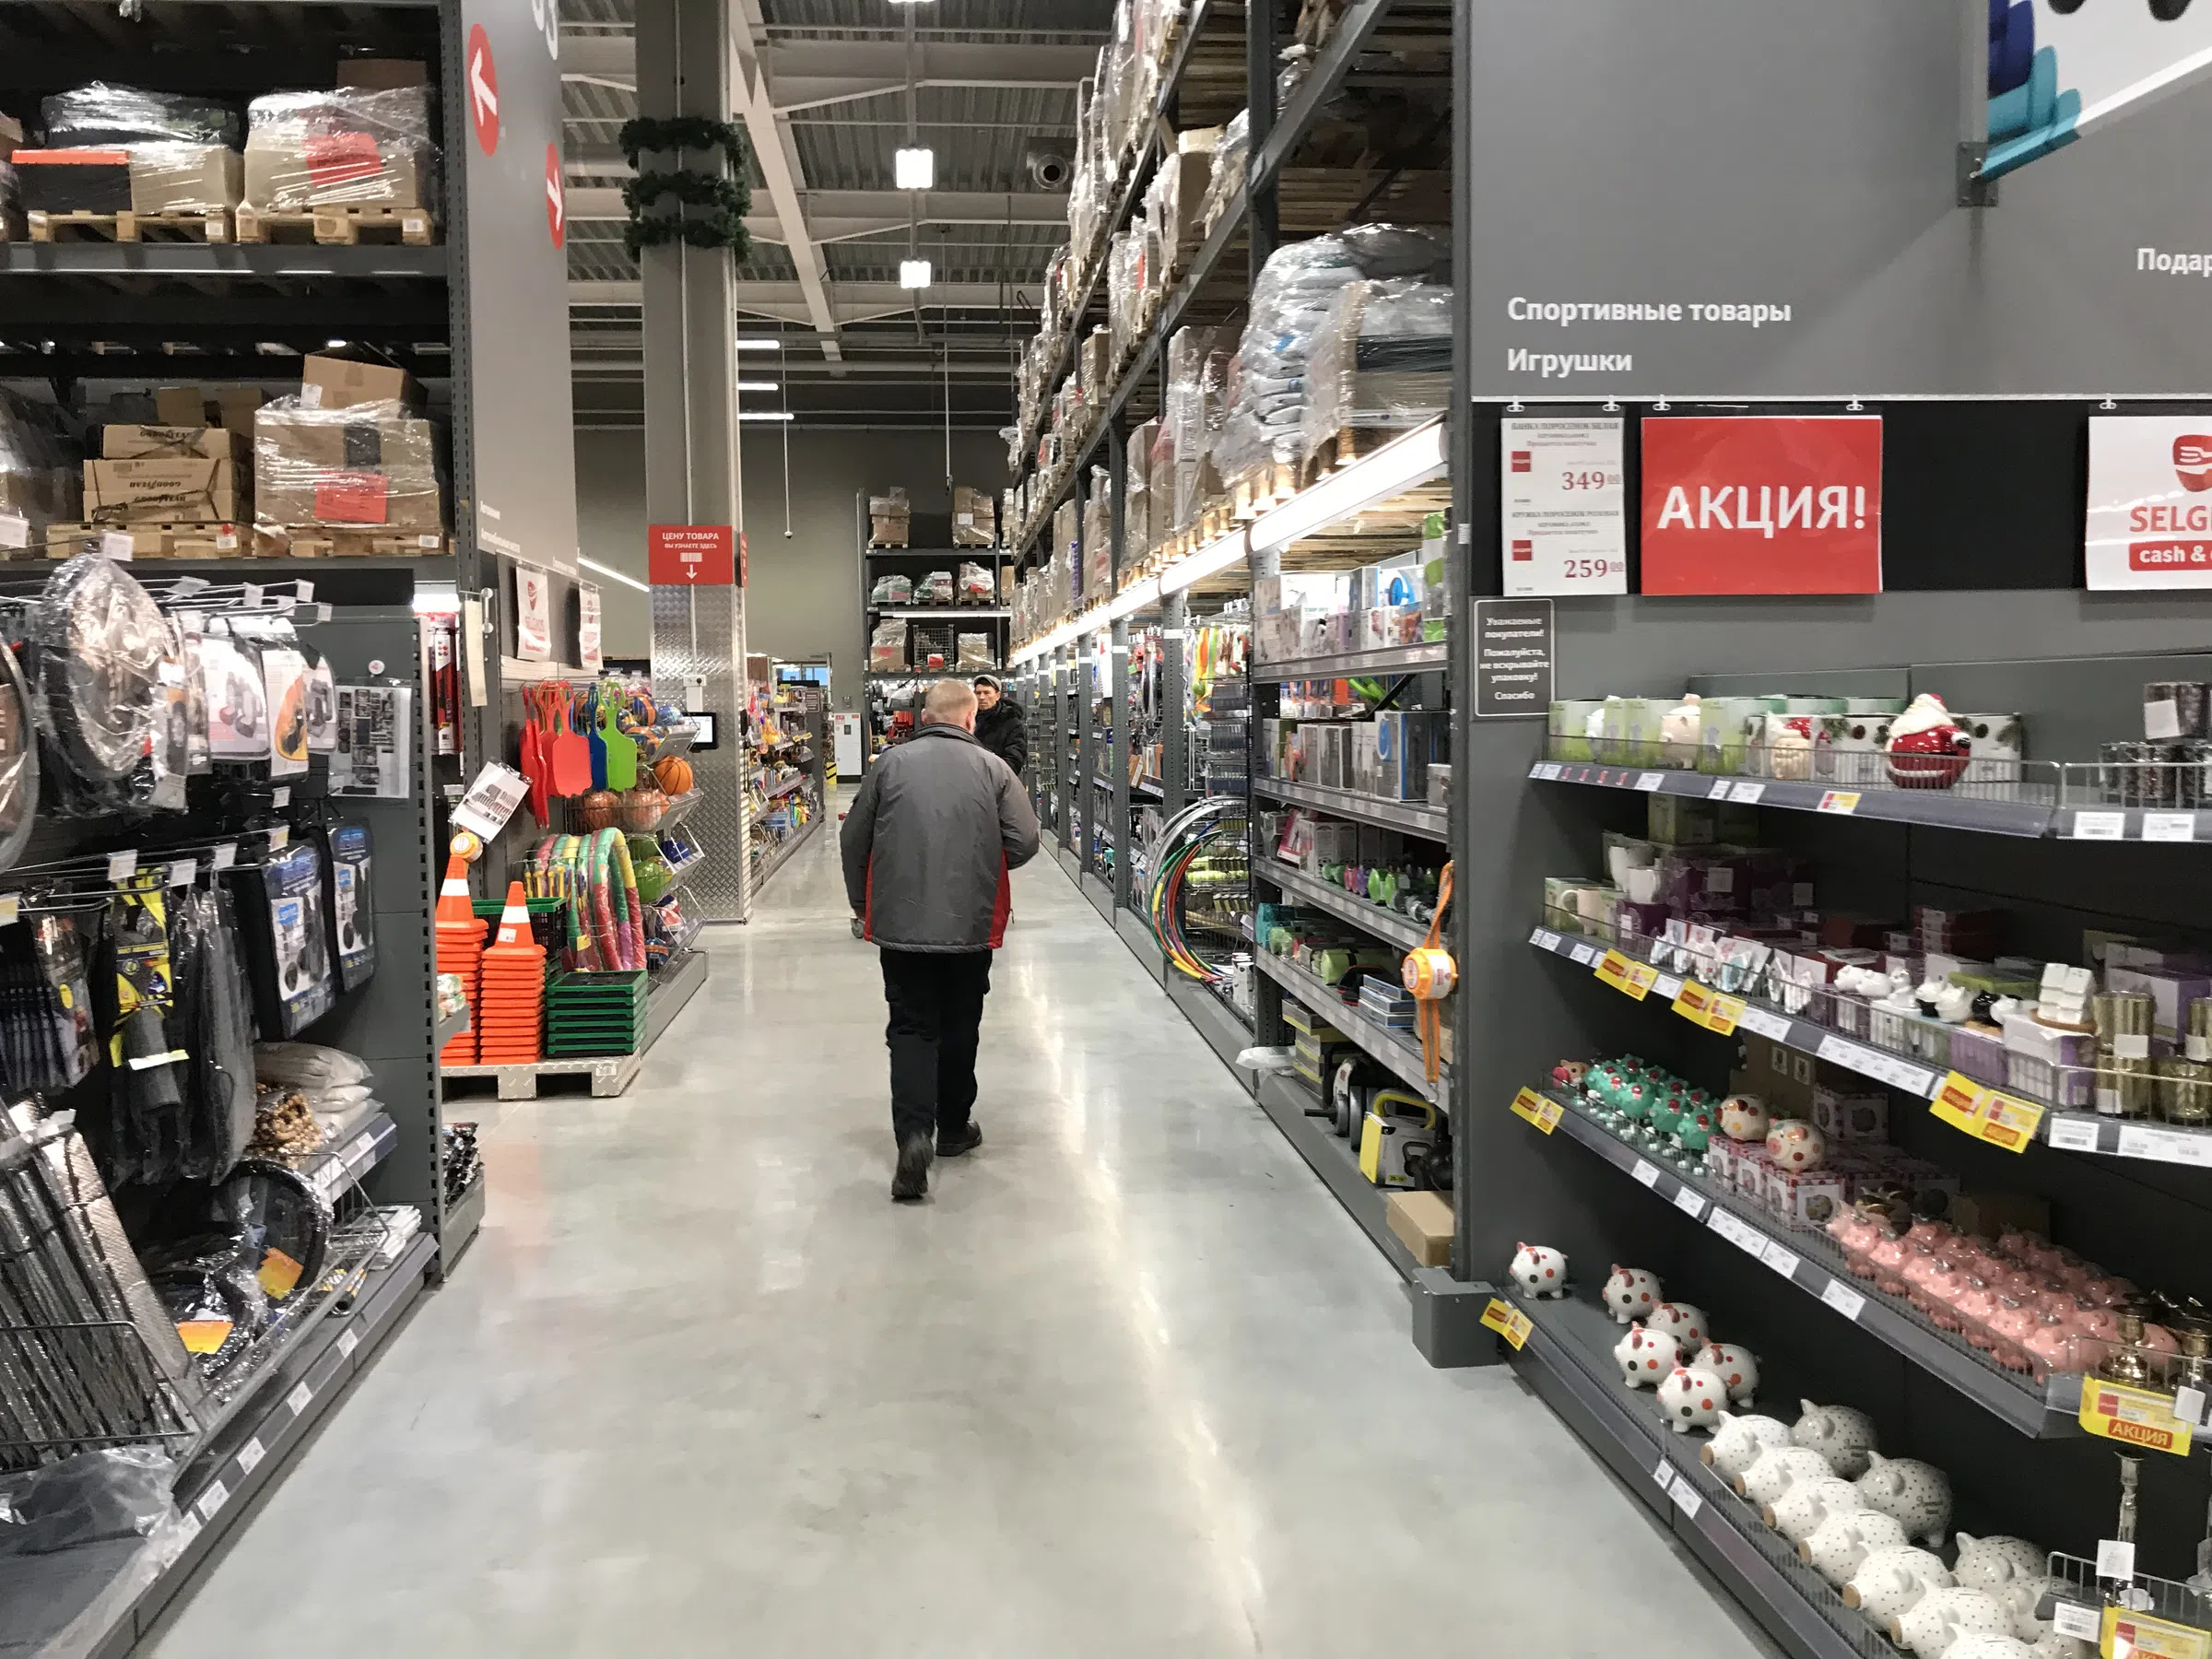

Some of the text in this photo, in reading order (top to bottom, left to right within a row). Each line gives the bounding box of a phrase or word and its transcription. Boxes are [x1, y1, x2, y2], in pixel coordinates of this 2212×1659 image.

[1508, 296, 1792, 328] Спортивные товары
[1508, 347, 1633, 379] Игрушки
[1561, 471, 1606, 490] 349
[1656, 485, 1866, 539] АКЦИЯ!
[2129, 505, 2212, 533] SELG
[662, 532, 720, 542] ЦЕНУ ТОВАРА
[2139, 545, 2206, 563] cash &
[1563, 559, 1608, 578] 259
[2112, 1421, 2169, 1446] АКЦИЯ
